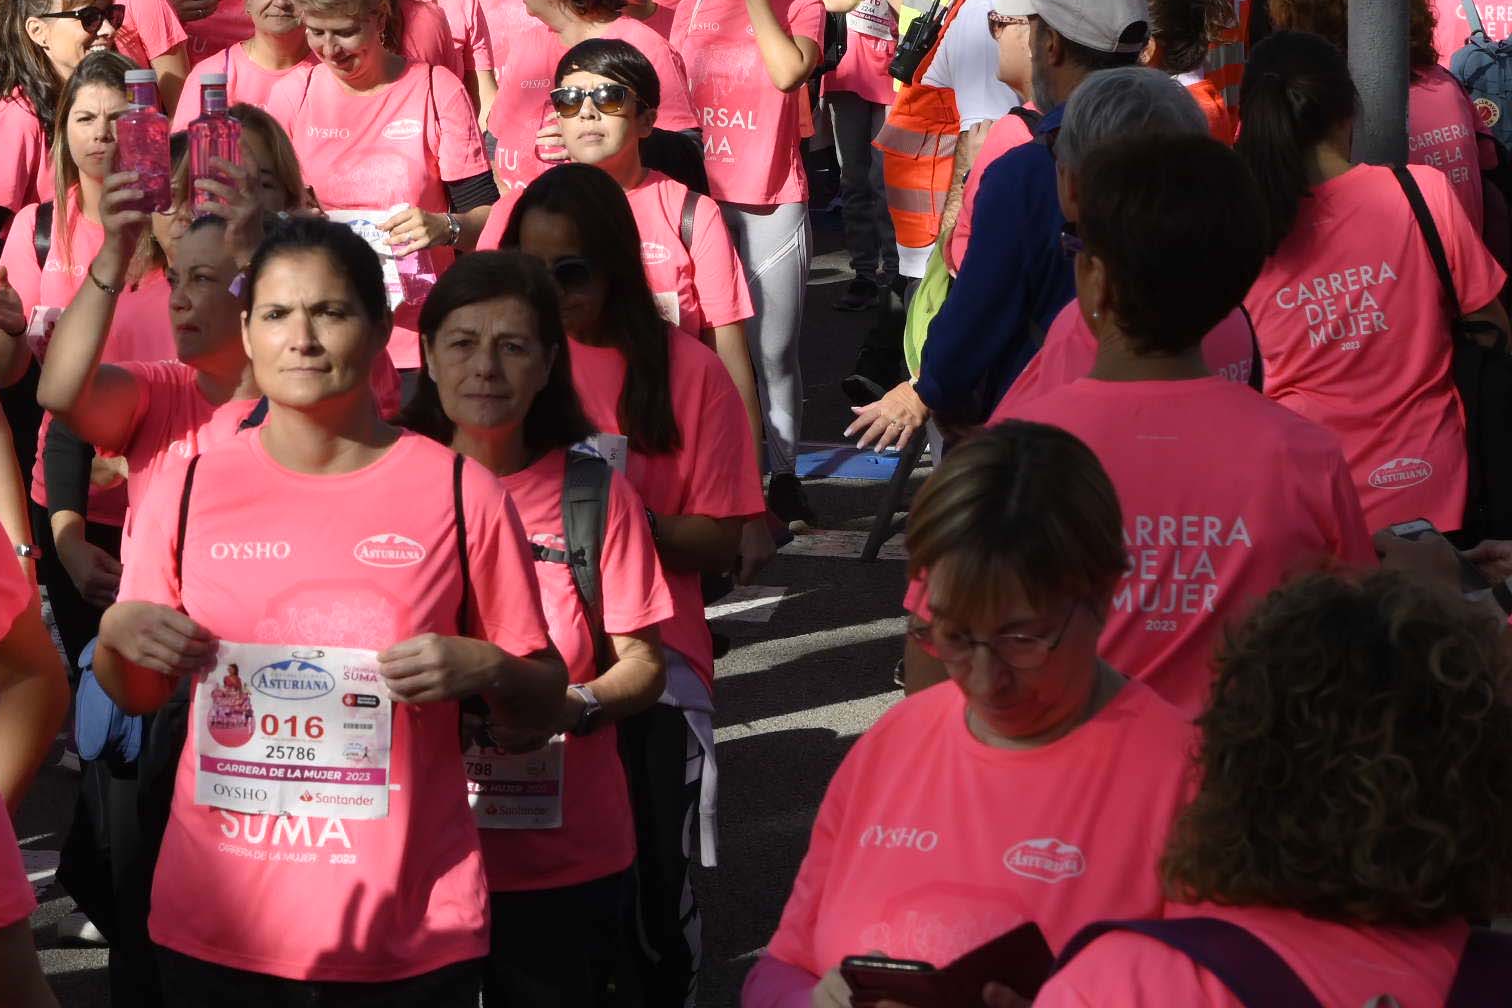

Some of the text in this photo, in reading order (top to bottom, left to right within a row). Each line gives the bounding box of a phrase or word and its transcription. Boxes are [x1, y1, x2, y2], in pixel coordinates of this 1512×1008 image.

[696, 107, 757, 130] RSAL
[1408, 124, 1469, 152] CARRERA
[496, 147, 519, 171] TU
[1424, 146, 1464, 167] DE LA
[1275, 260, 1398, 310] CARRERA
[1304, 290, 1379, 326] DE LA
[1308, 311, 1390, 349] MUJER
[1341, 340, 1361, 352] 2023
[1373, 466, 1428, 485] ASTURIANA
[210, 541, 291, 561] OYSHO
[360, 545, 421, 561] ASTURIANA
[1172, 550, 1217, 580] LA
[1112, 583, 1219, 614] MUJER
[1145, 619, 1177, 633] 2023
[257, 674, 329, 691] ASTURIANA
[343, 671, 378, 682] SUMA
[260, 713, 325, 739] 016
[265, 745, 316, 761] 25786
[216, 762, 371, 781] CARRERA DE LA MUJER 2023
[213, 783, 268, 802] OYSHO
[315, 792, 374, 806] Santander
[220, 811, 352, 848] SUMA
[329, 854, 357, 865] 2023
